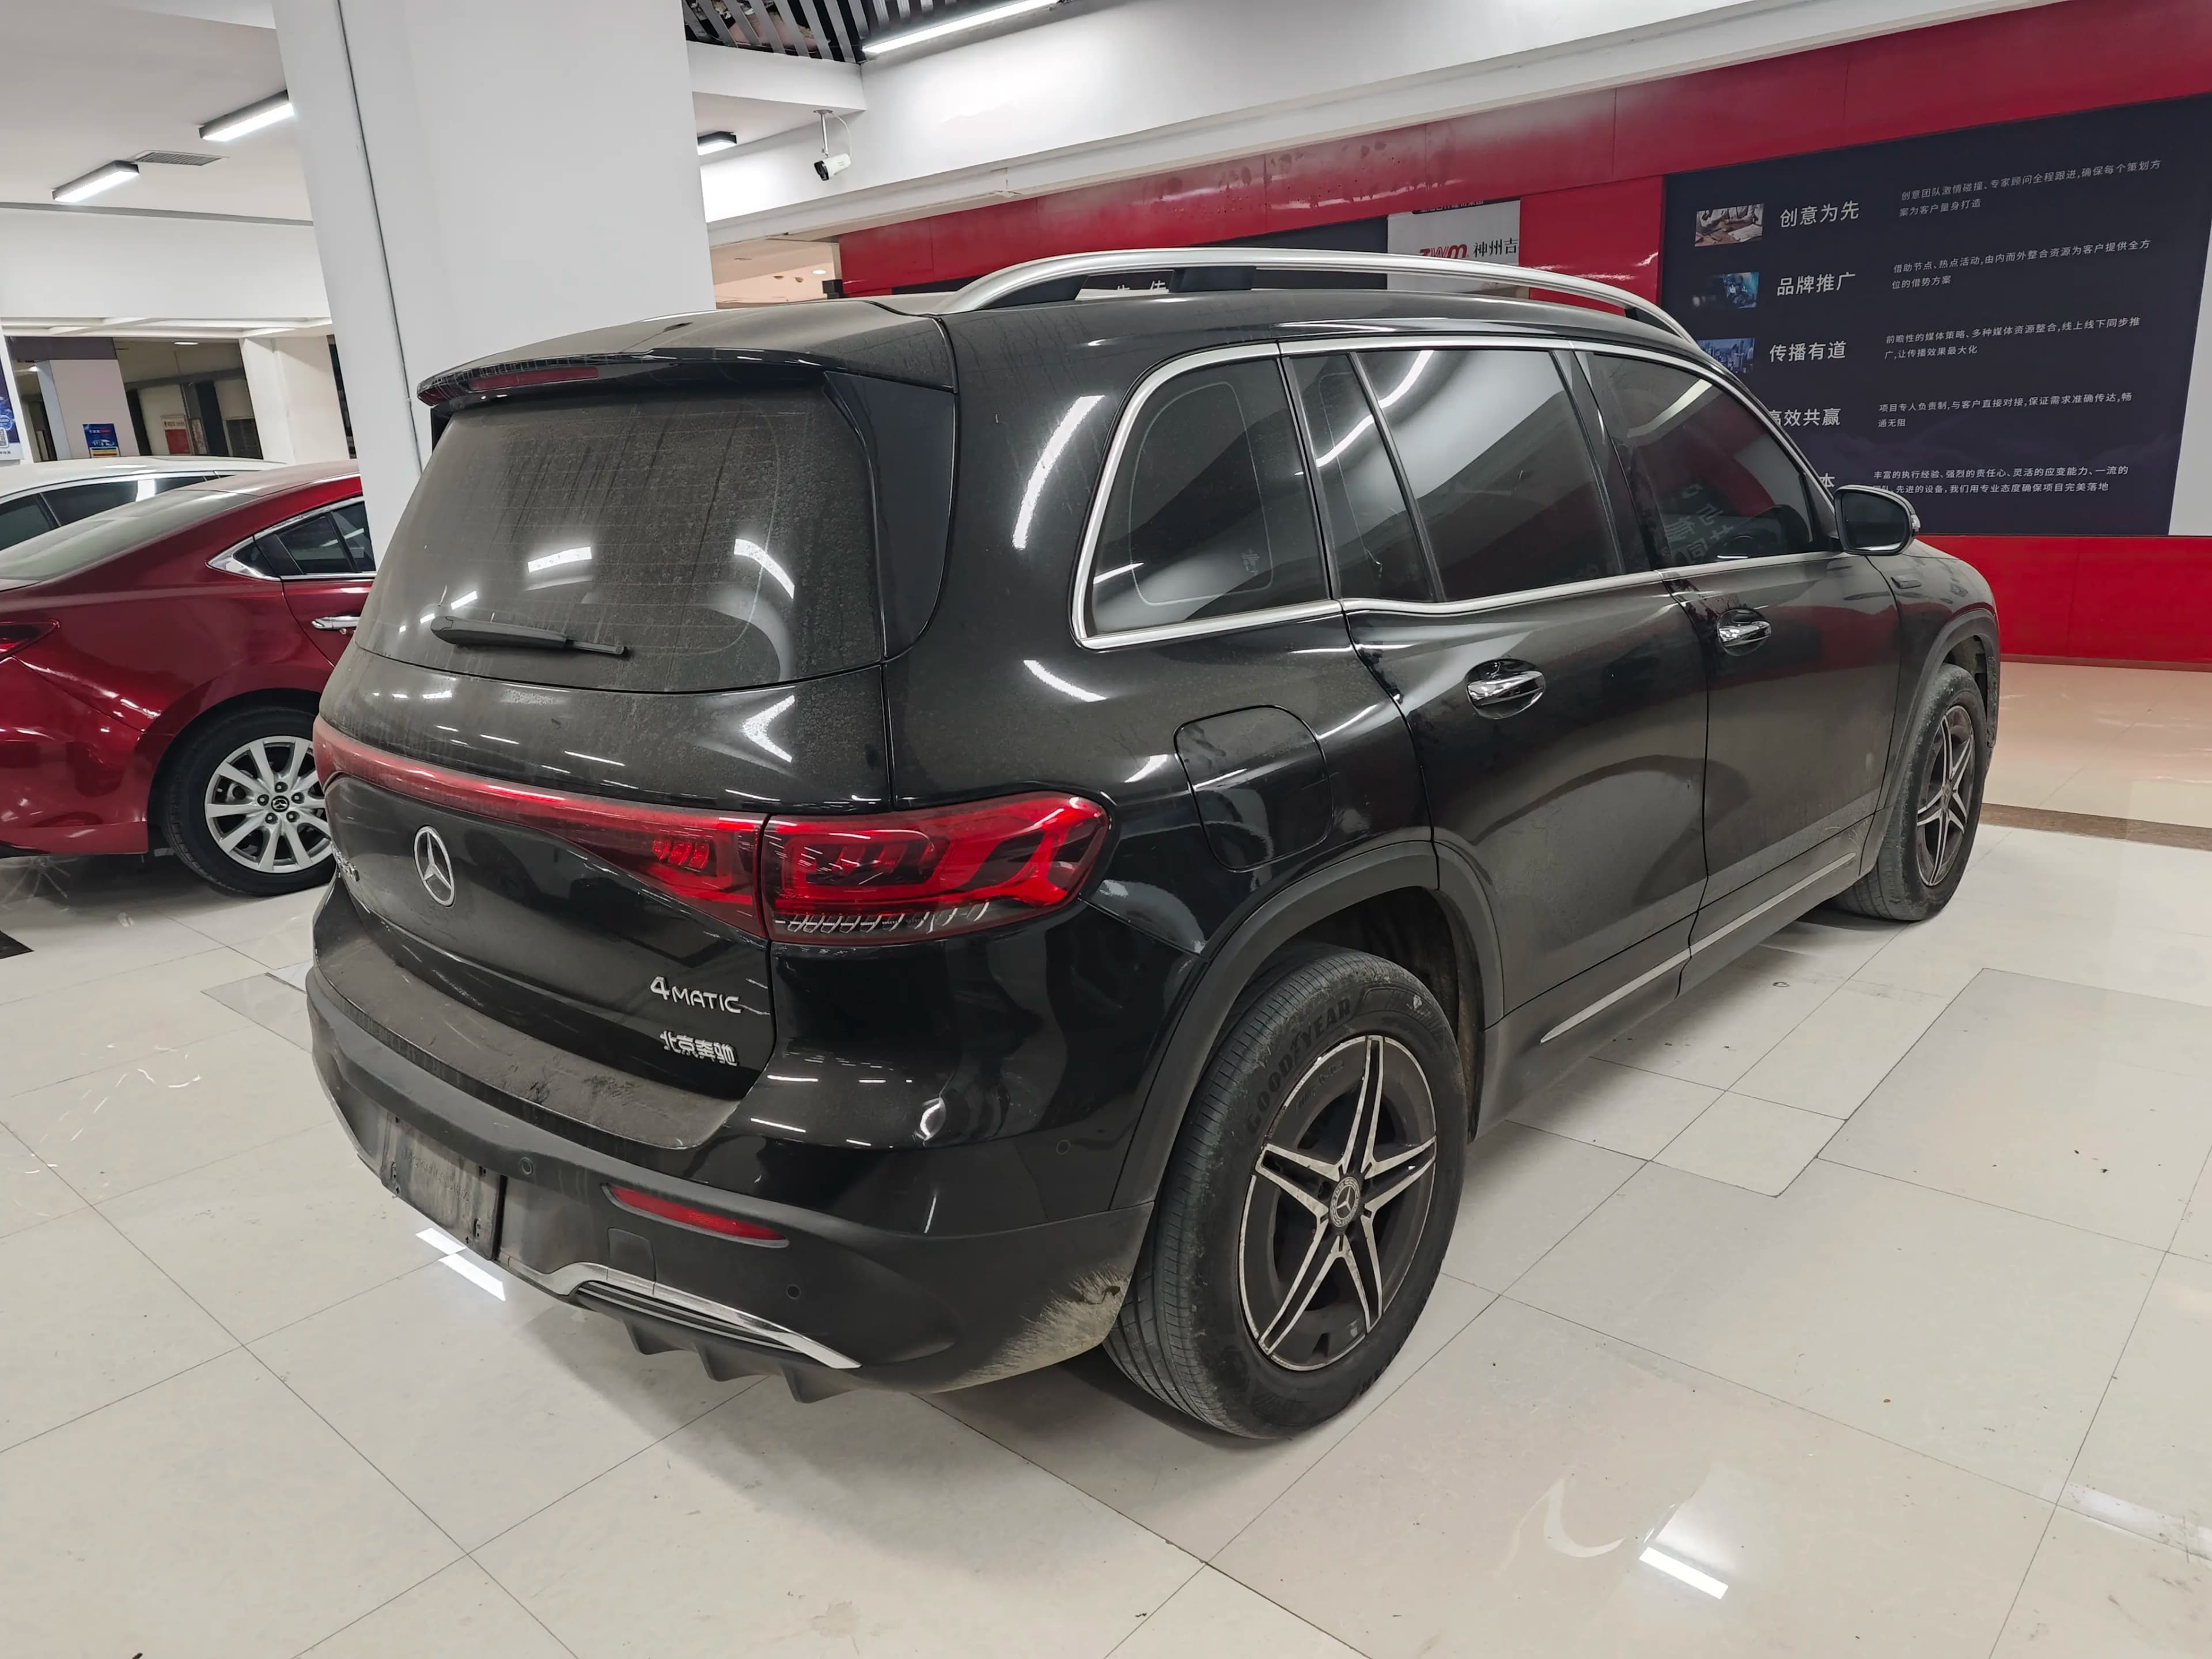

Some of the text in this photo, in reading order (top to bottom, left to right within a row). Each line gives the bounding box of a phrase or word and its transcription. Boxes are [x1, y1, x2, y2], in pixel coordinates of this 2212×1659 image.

[1779, 200, 1859, 228] 创意为先
[1899, 198, 1982, 217] 案为客户量身打造
[1473, 237, 1519, 257] 神州吉
[1777, 271, 1856, 296] 品牌推广
[1892, 275, 1952, 289] 位的借势方案
[1769, 340, 1847, 362] 传播有道
[1878, 418, 1906, 427] 通无阻
[650, 975, 741, 1014] 4MATIC
[659, 1030, 738, 1067] 北京奔驰
